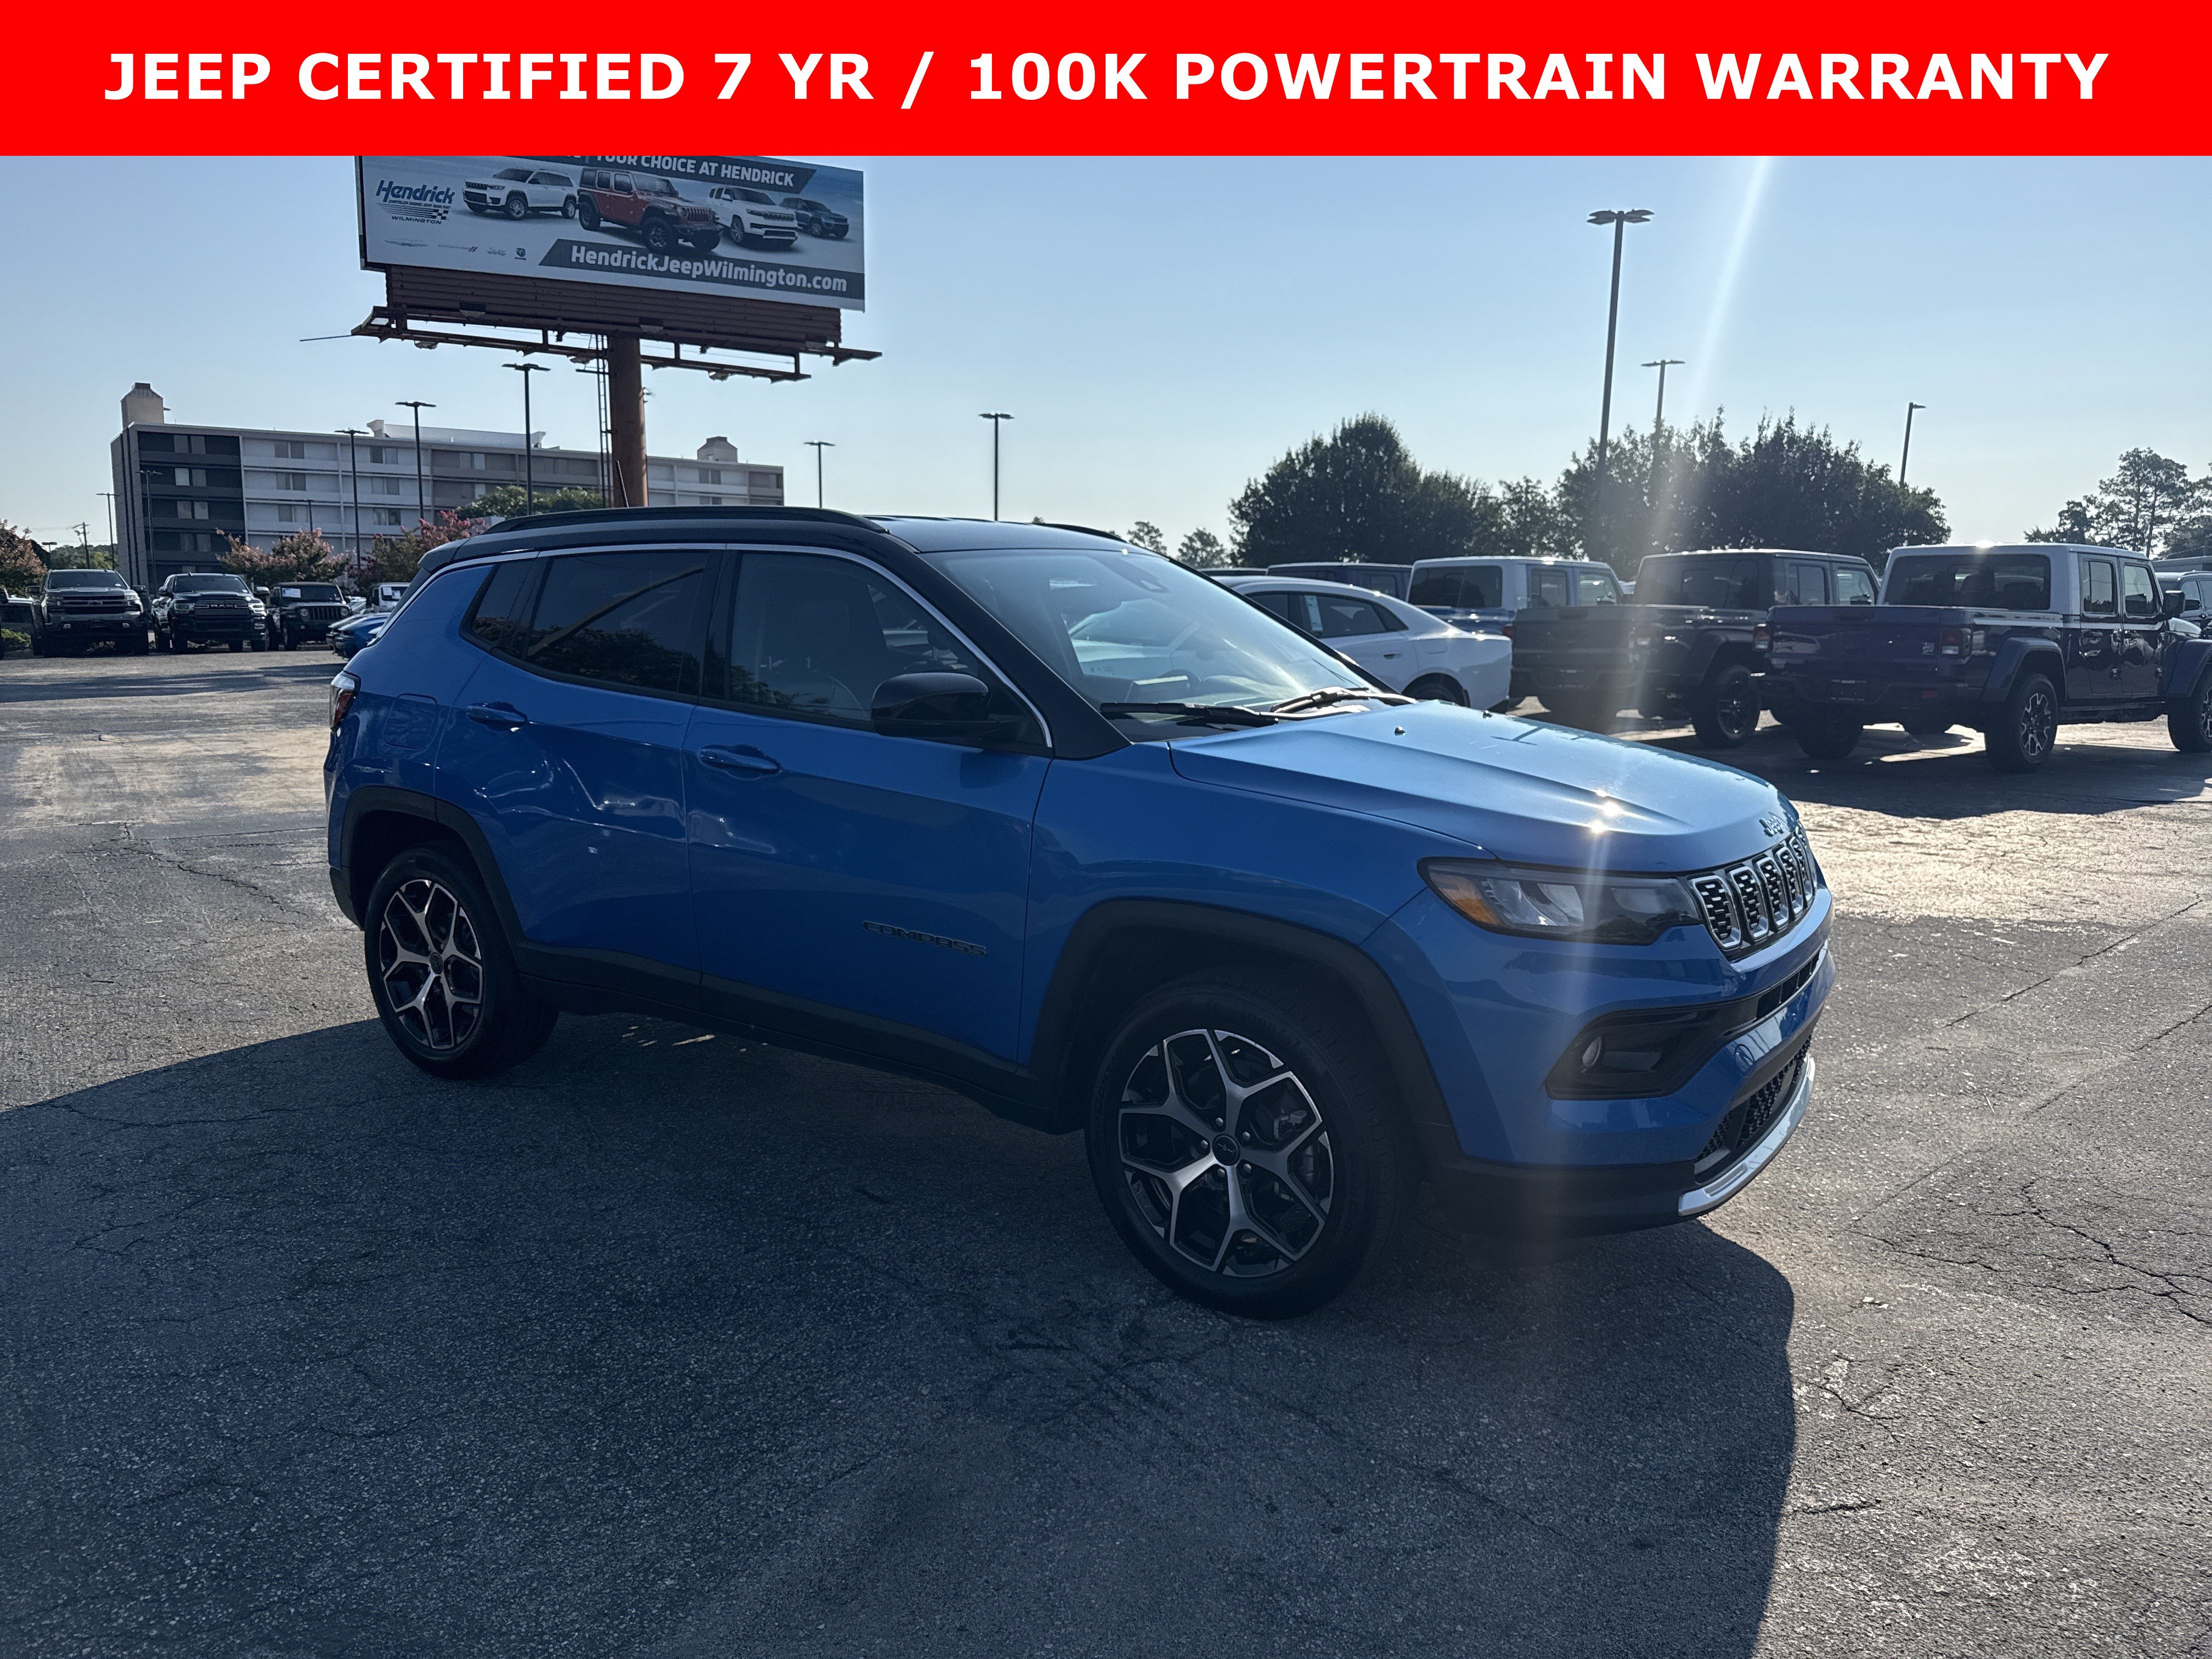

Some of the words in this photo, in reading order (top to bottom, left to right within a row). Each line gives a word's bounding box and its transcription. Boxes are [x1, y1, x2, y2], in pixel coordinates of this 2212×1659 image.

[641, 156, 697, 173] CHOICE
[699, 161, 719, 176] AT
[721, 164, 795, 187] HENDRICK
[375, 180, 455, 204] Hendrick
[391, 216, 442, 224] WILMINGTON
[571, 245, 847, 292] HendrickJeepWilmington.com
[863, 921, 987, 957] COMPASS
